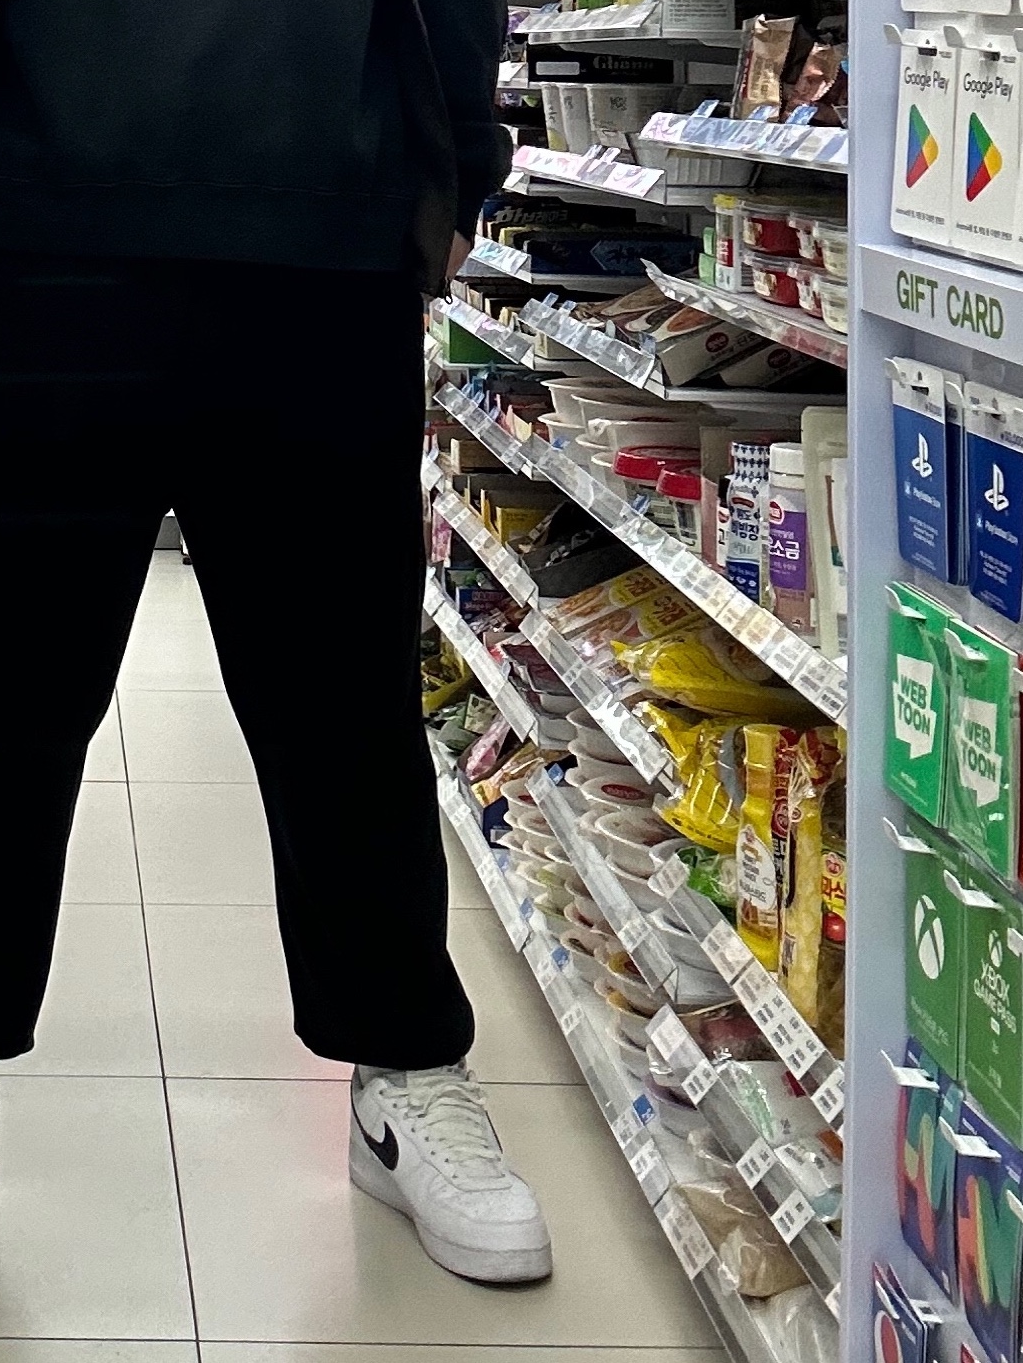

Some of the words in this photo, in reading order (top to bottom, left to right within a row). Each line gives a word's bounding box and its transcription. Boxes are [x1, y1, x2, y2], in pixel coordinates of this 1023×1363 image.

[904, 65, 932, 91] Google
[933, 67, 950, 95] Play
[963, 73, 994, 99] Google
[995, 75, 1014, 103] Play
[897, 270, 939, 318] GIFT
[946, 284, 1004, 341] CARD
[900, 673, 927, 710] WEB
[897, 694, 931, 737] TOON
[964, 719, 992, 754] WEB
[961, 738, 997, 783] TOON
[981, 958, 1011, 1008] XBOX
